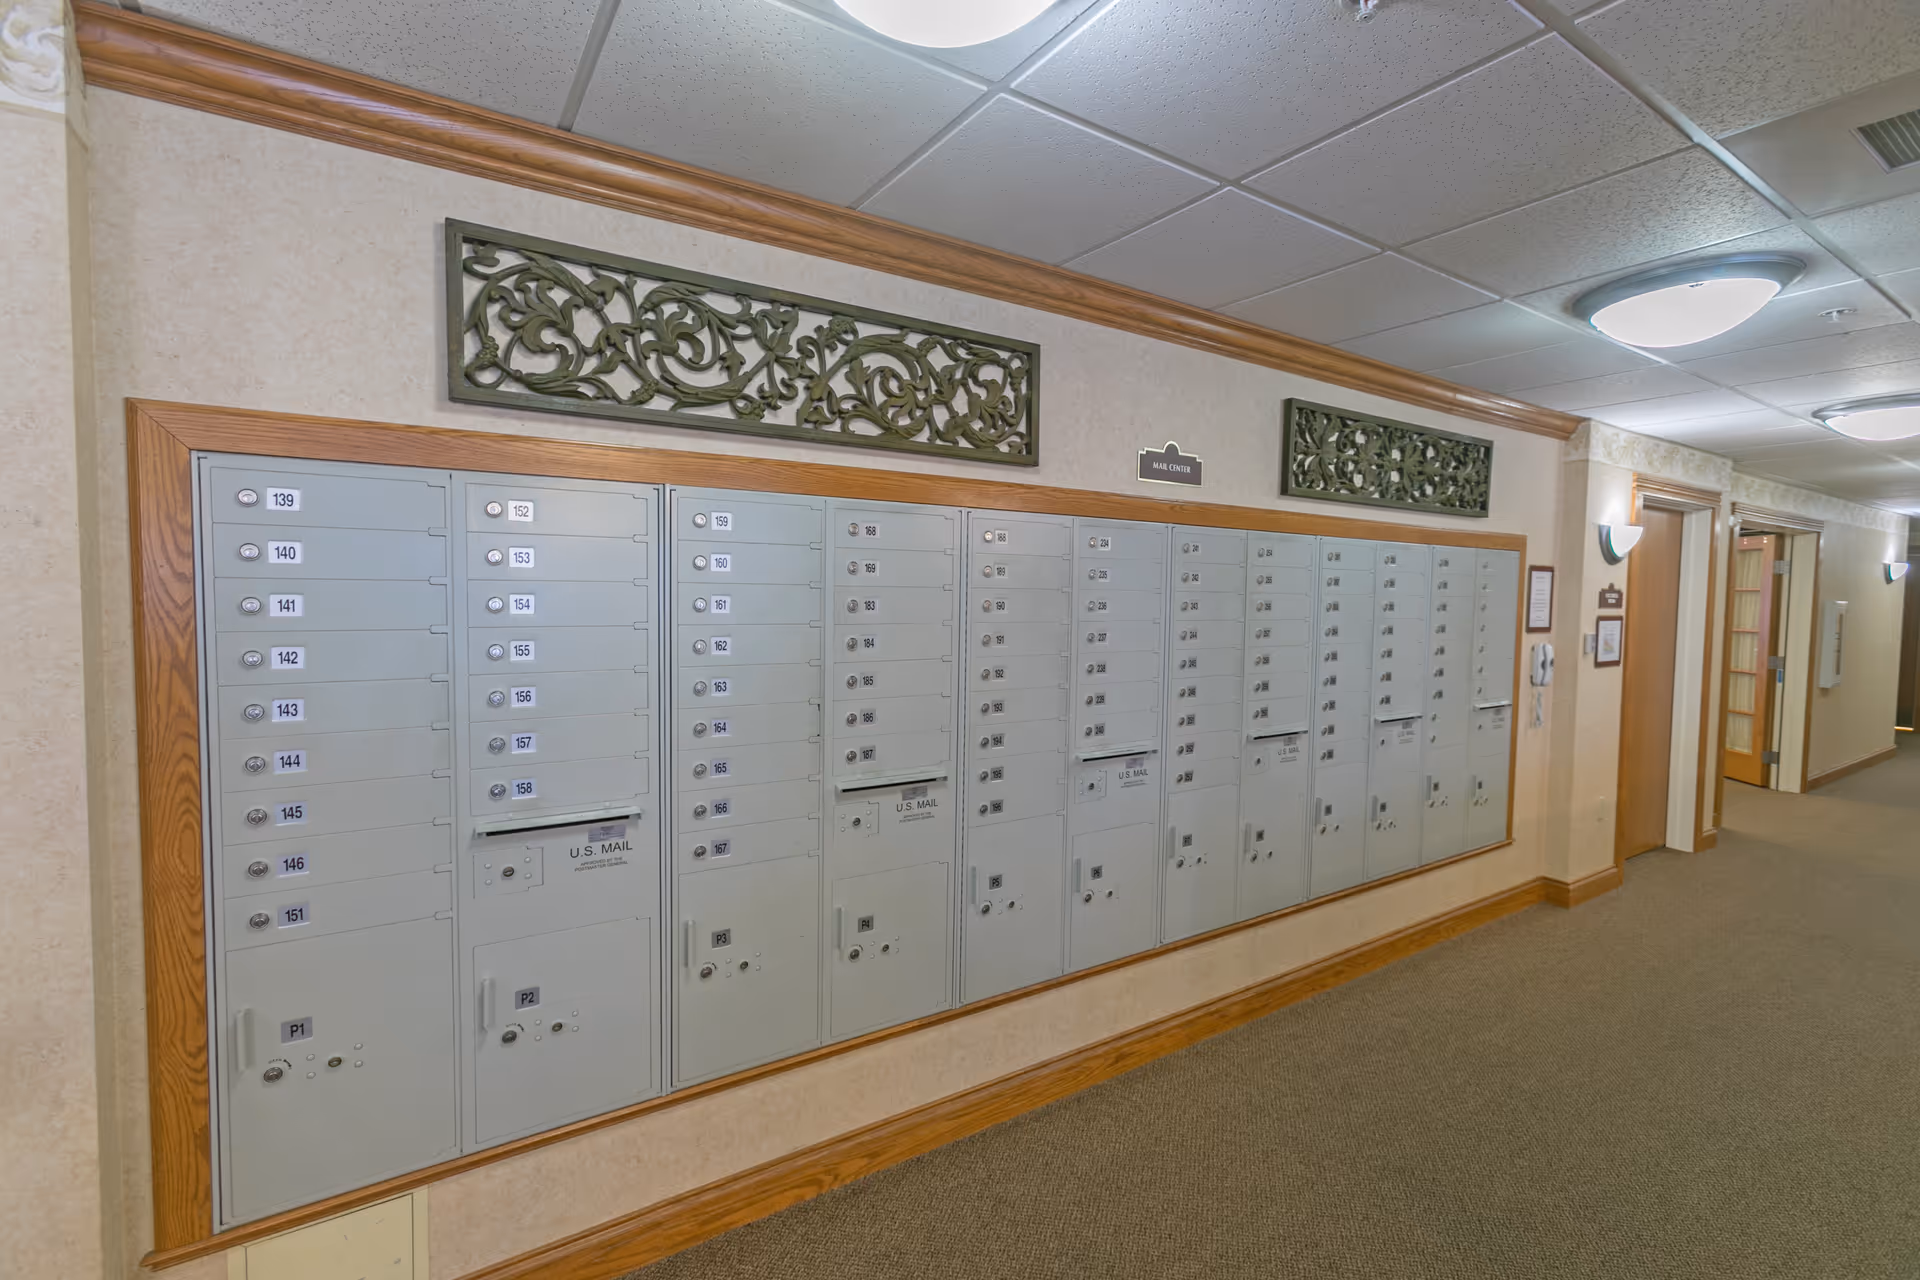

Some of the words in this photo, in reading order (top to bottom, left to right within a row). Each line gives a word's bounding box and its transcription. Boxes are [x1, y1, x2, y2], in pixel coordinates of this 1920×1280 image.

[1153, 462, 1168, 470] MAIL
[1169, 464, 1191, 473] CENTER
[272, 493, 294, 507] 139
[513, 505, 529, 518] 152
[715, 516, 728, 527] 159
[865, 526, 876, 535] 168
[1100, 539, 1109, 548] 234
[274, 546, 296, 560] 140
[513, 551, 530, 564] 153
[714, 558, 728, 569] 160
[865, 563, 876, 573] 169
[1098, 570, 1107, 579] 235
[277, 600, 296, 613] 141
[514, 598, 530, 611] 154
[714, 600, 726, 610] 161
[864, 601, 875, 610] 183
[996, 602, 1005, 610] 190
[863, 638, 874, 648] 184
[996, 635, 1004, 644] 191
[1098, 633, 1107, 642] 237
[514, 644, 530, 657] 155
[714, 640, 728, 651] 162
[277, 651, 298, 665] 142
[995, 669, 1004, 678] 192
[862, 676, 874, 686] 185
[713, 682, 727, 692] 163
[515, 690, 532, 703] 156
[276, 703, 298, 717] 143
[994, 703, 1003, 712] 193
[862, 713, 874, 722] 186
[713, 722, 726, 733] 164
[516, 736, 531, 749] 157
[993, 736, 1002, 746] 194
[862, 750, 873, 760] 187
[279, 754, 300, 769] 144
[714, 763, 727, 774] 165
[992, 769, 1002, 779] 195
[1119, 771, 1132, 779] U.S.
[516, 782, 532, 795] 158
[714, 803, 727, 814] 166
[897, 802, 914, 812] U.S.
[917, 799, 938, 809] MAIL
[281, 806, 303, 820] 145
[570, 846, 596, 858] U.S.
[602, 841, 632, 854] MAIL
[714, 843, 727, 854] 167
[283, 857, 304, 871] 146
[285, 908, 303, 922] 151
[862, 920, 870, 929] P4
[716, 933, 727, 944] P3
[521, 992, 534, 1004] P2
[290, 1023, 305, 1037] P1
